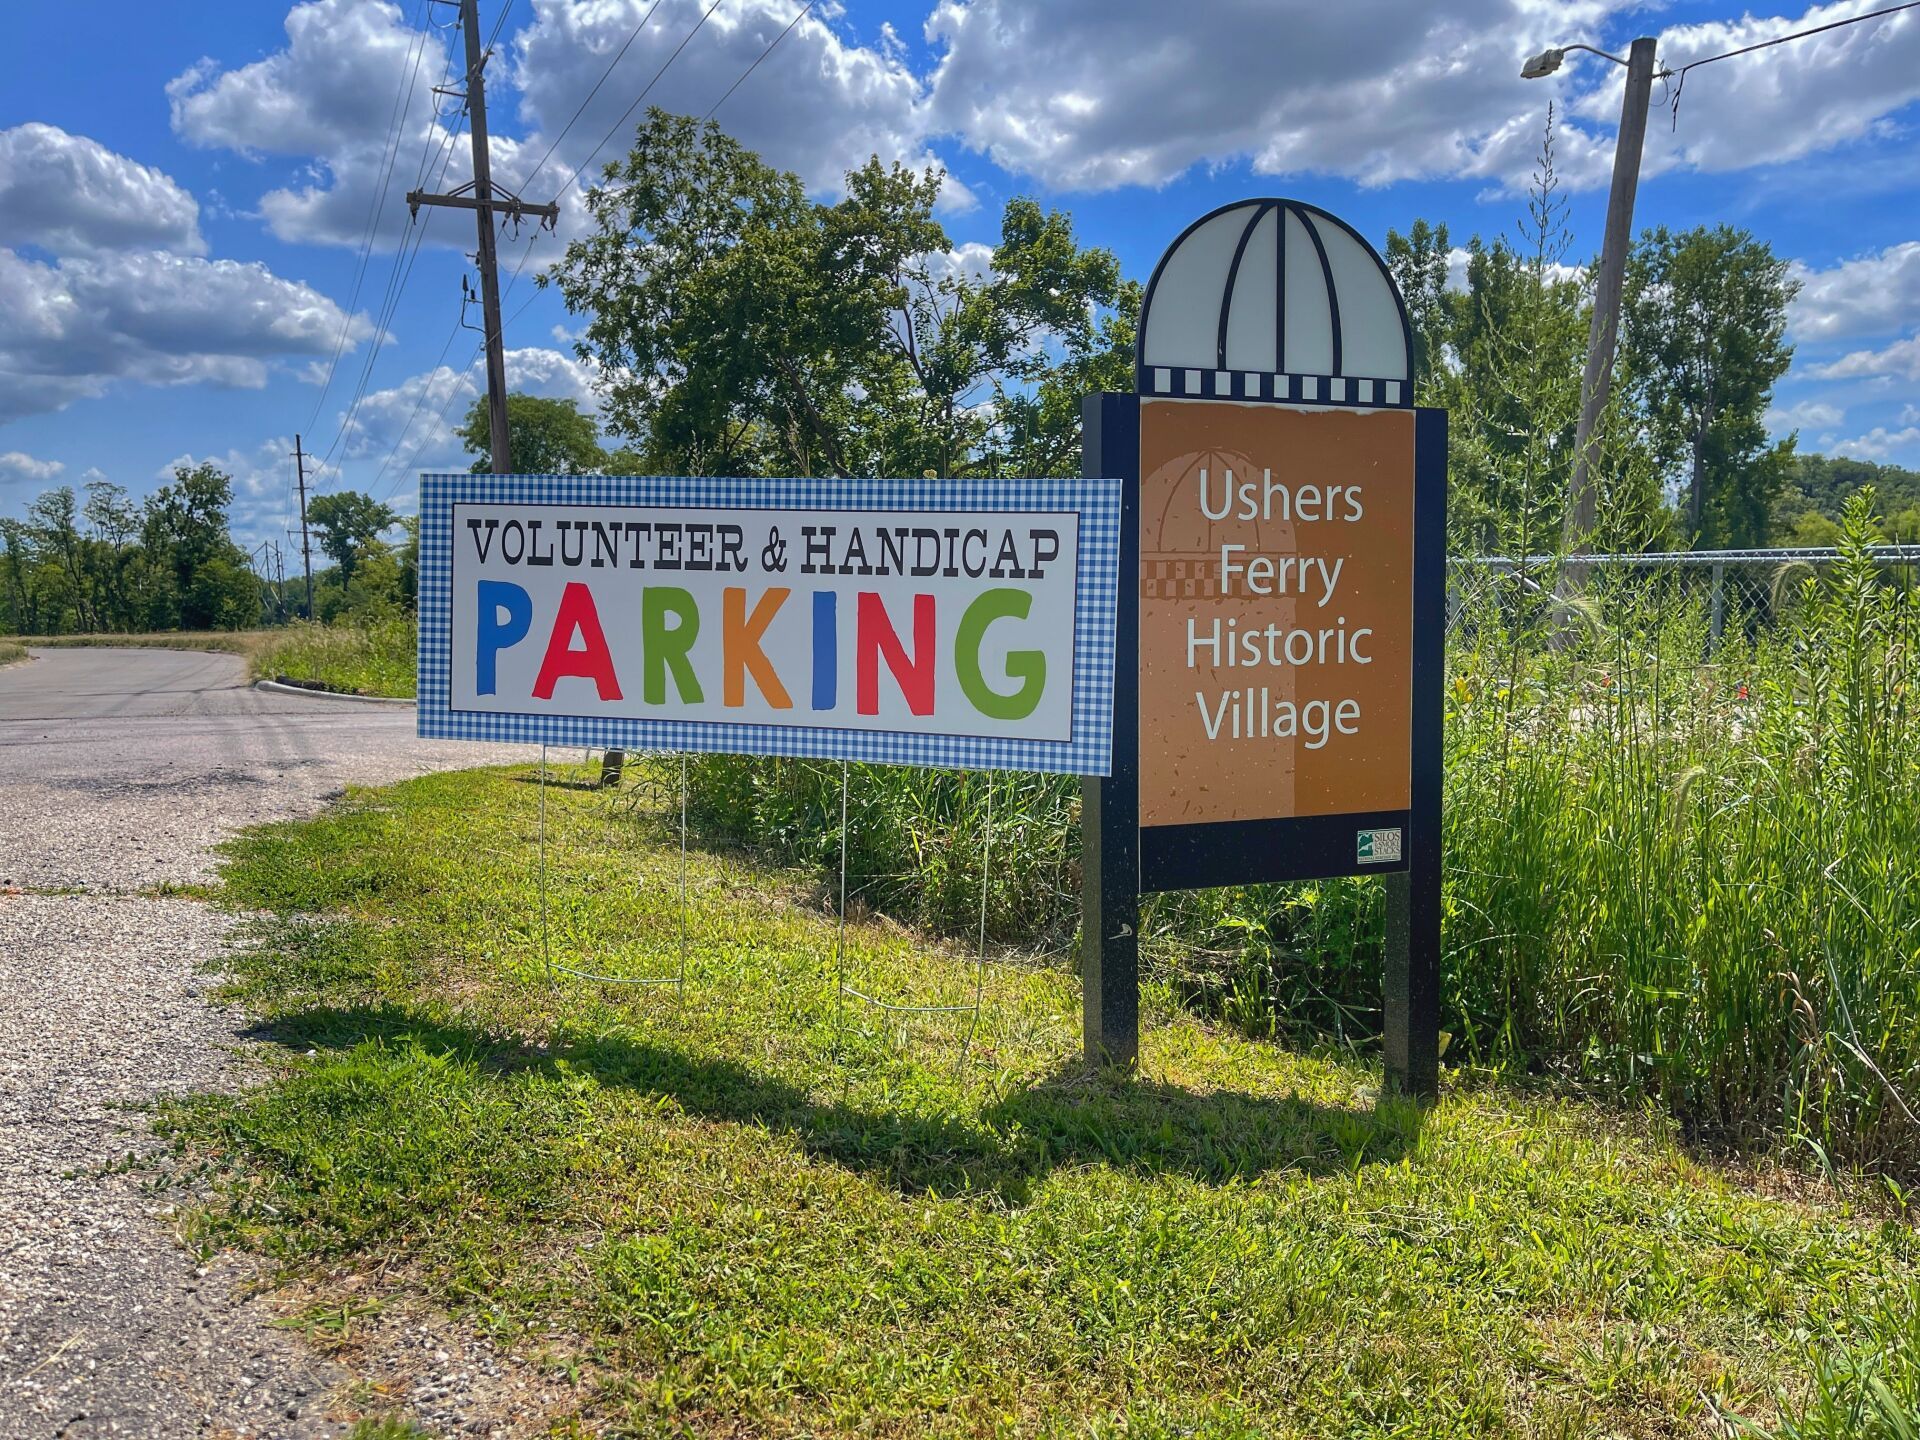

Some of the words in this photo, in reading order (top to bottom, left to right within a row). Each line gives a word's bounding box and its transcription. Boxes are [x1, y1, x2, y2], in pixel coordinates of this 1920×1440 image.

[1199, 468, 1364, 522] Ushers
[467, 518, 749, 573] VOLUNTEER
[761, 525, 788, 573] &
[800, 526, 1060, 580] HANDICAP
[1220, 544, 1344, 608] Ferry
[476, 580, 1046, 720] PARKING
[1187, 616, 1373, 668] Historic
[1195, 688, 1361, 750] Village
[1374, 831, 1400, 842] SILOS
